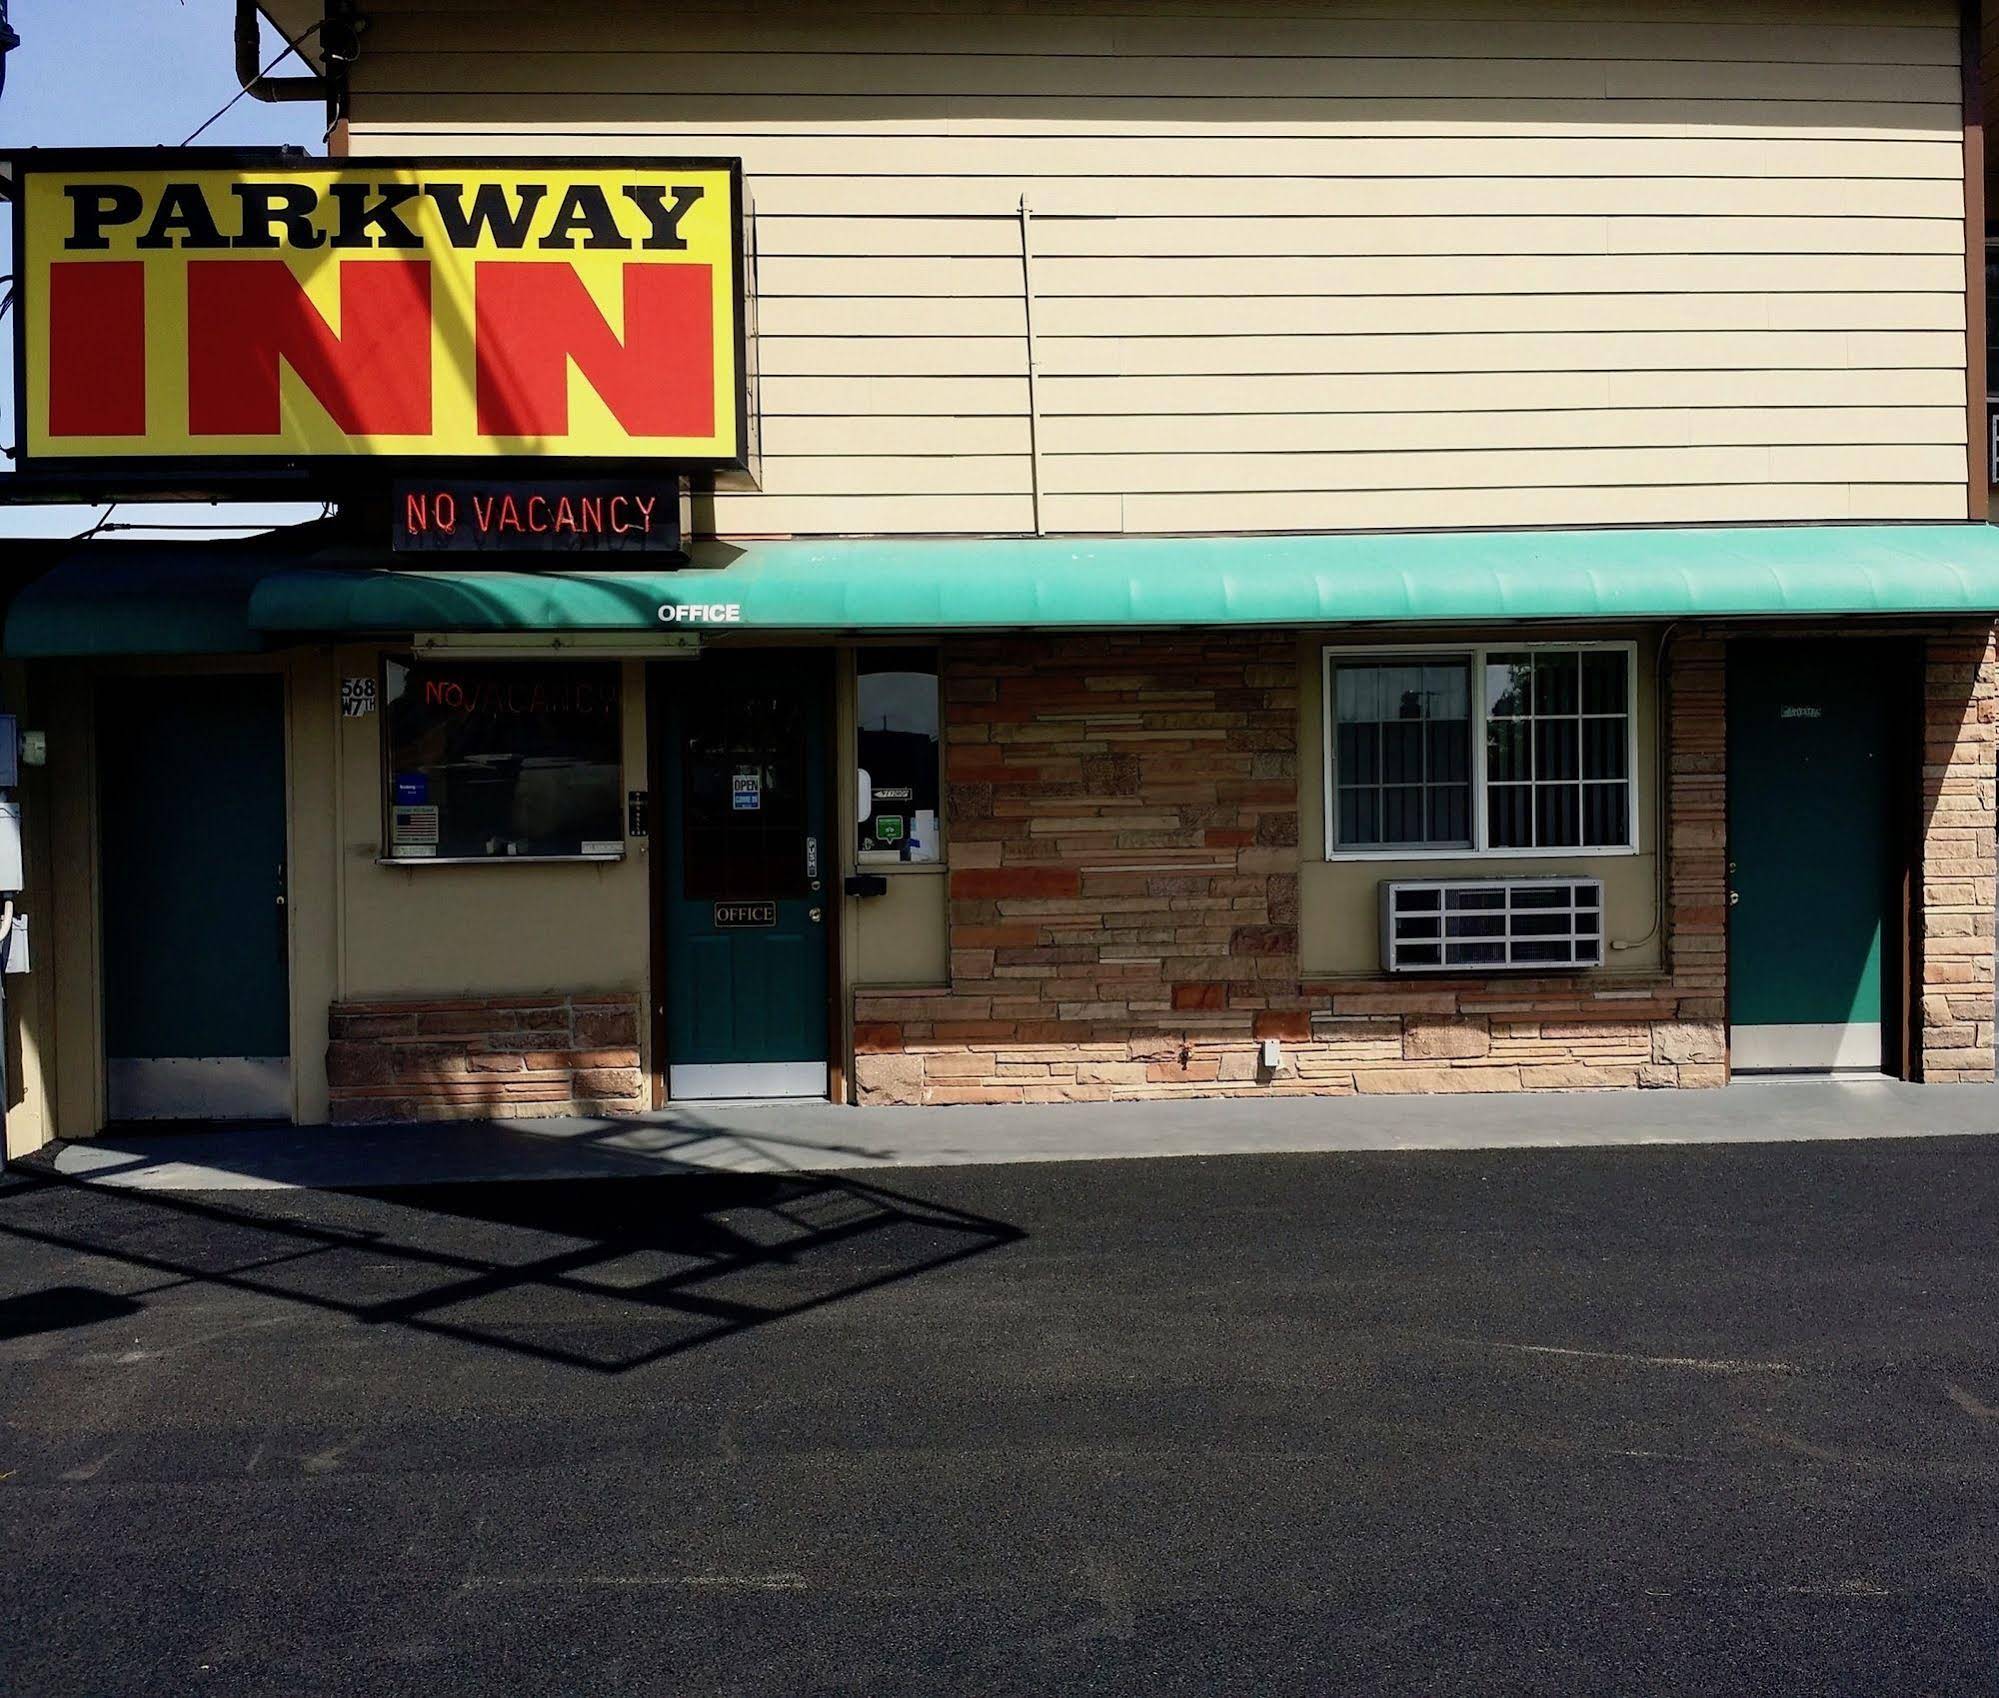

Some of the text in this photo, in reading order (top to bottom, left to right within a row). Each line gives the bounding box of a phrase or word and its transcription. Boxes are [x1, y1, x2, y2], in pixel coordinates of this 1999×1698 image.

[63, 182, 705, 251] PARKWAY
[49, 260, 715, 438] INN
[406, 493, 656, 535] NO VACANCY
[657, 604, 740, 622] OFFICE
[341, 679, 376, 697] 568
[424, 680, 464, 707] NO
[734, 779, 759, 791] OPEN
[717, 907, 774, 921] OFFICE
